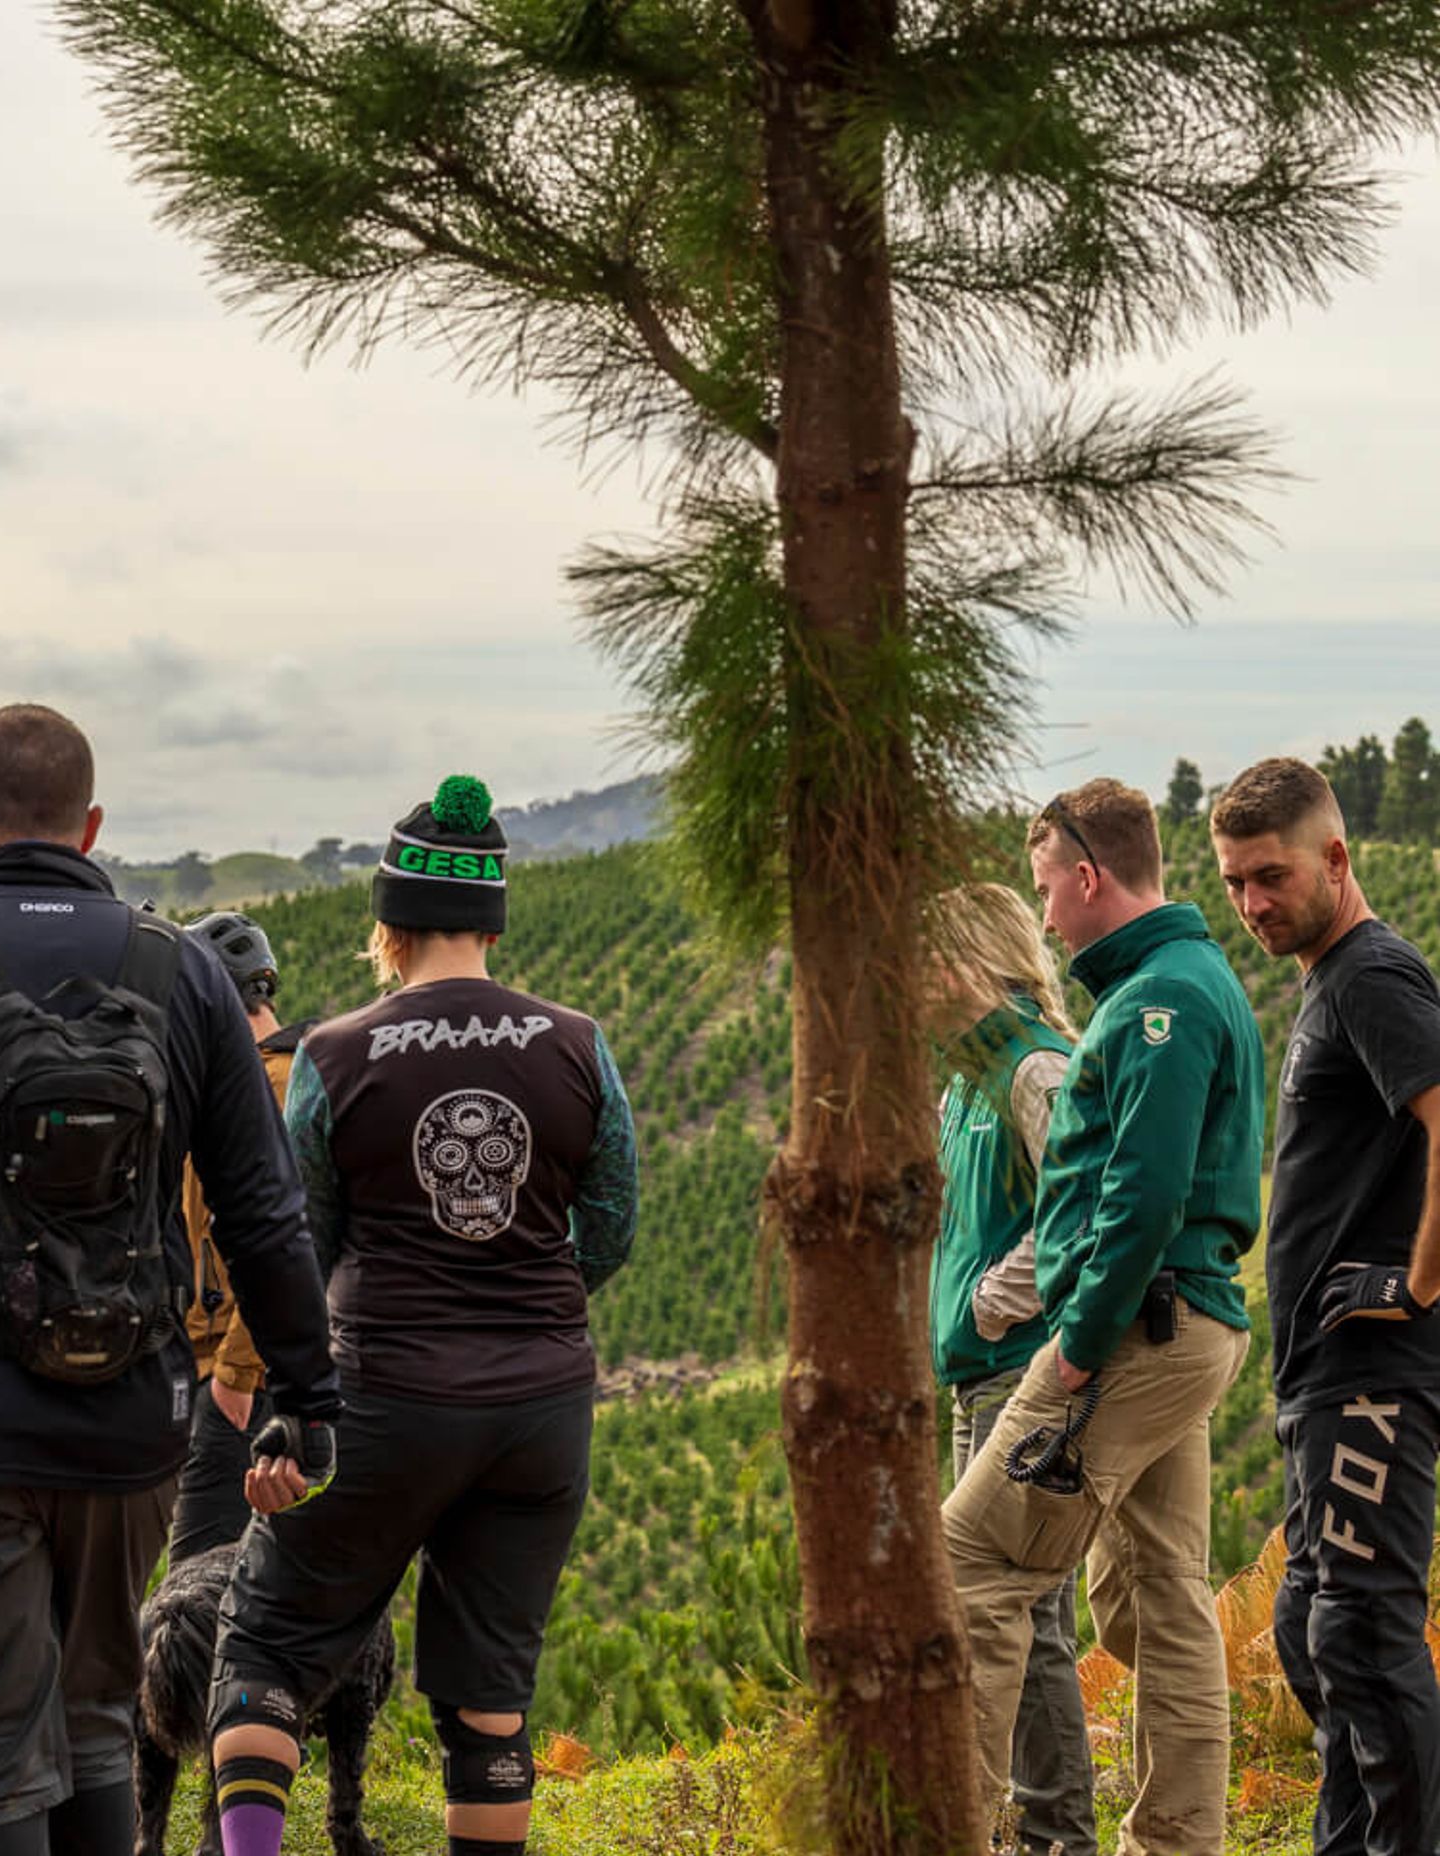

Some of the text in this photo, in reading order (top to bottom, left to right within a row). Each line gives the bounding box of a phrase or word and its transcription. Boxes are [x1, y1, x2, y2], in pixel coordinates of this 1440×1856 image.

[398, 845, 501, 880] GESA
[367, 1014, 555, 1061] BRAAAP
[1321, 1394, 1401, 1562] FOX
